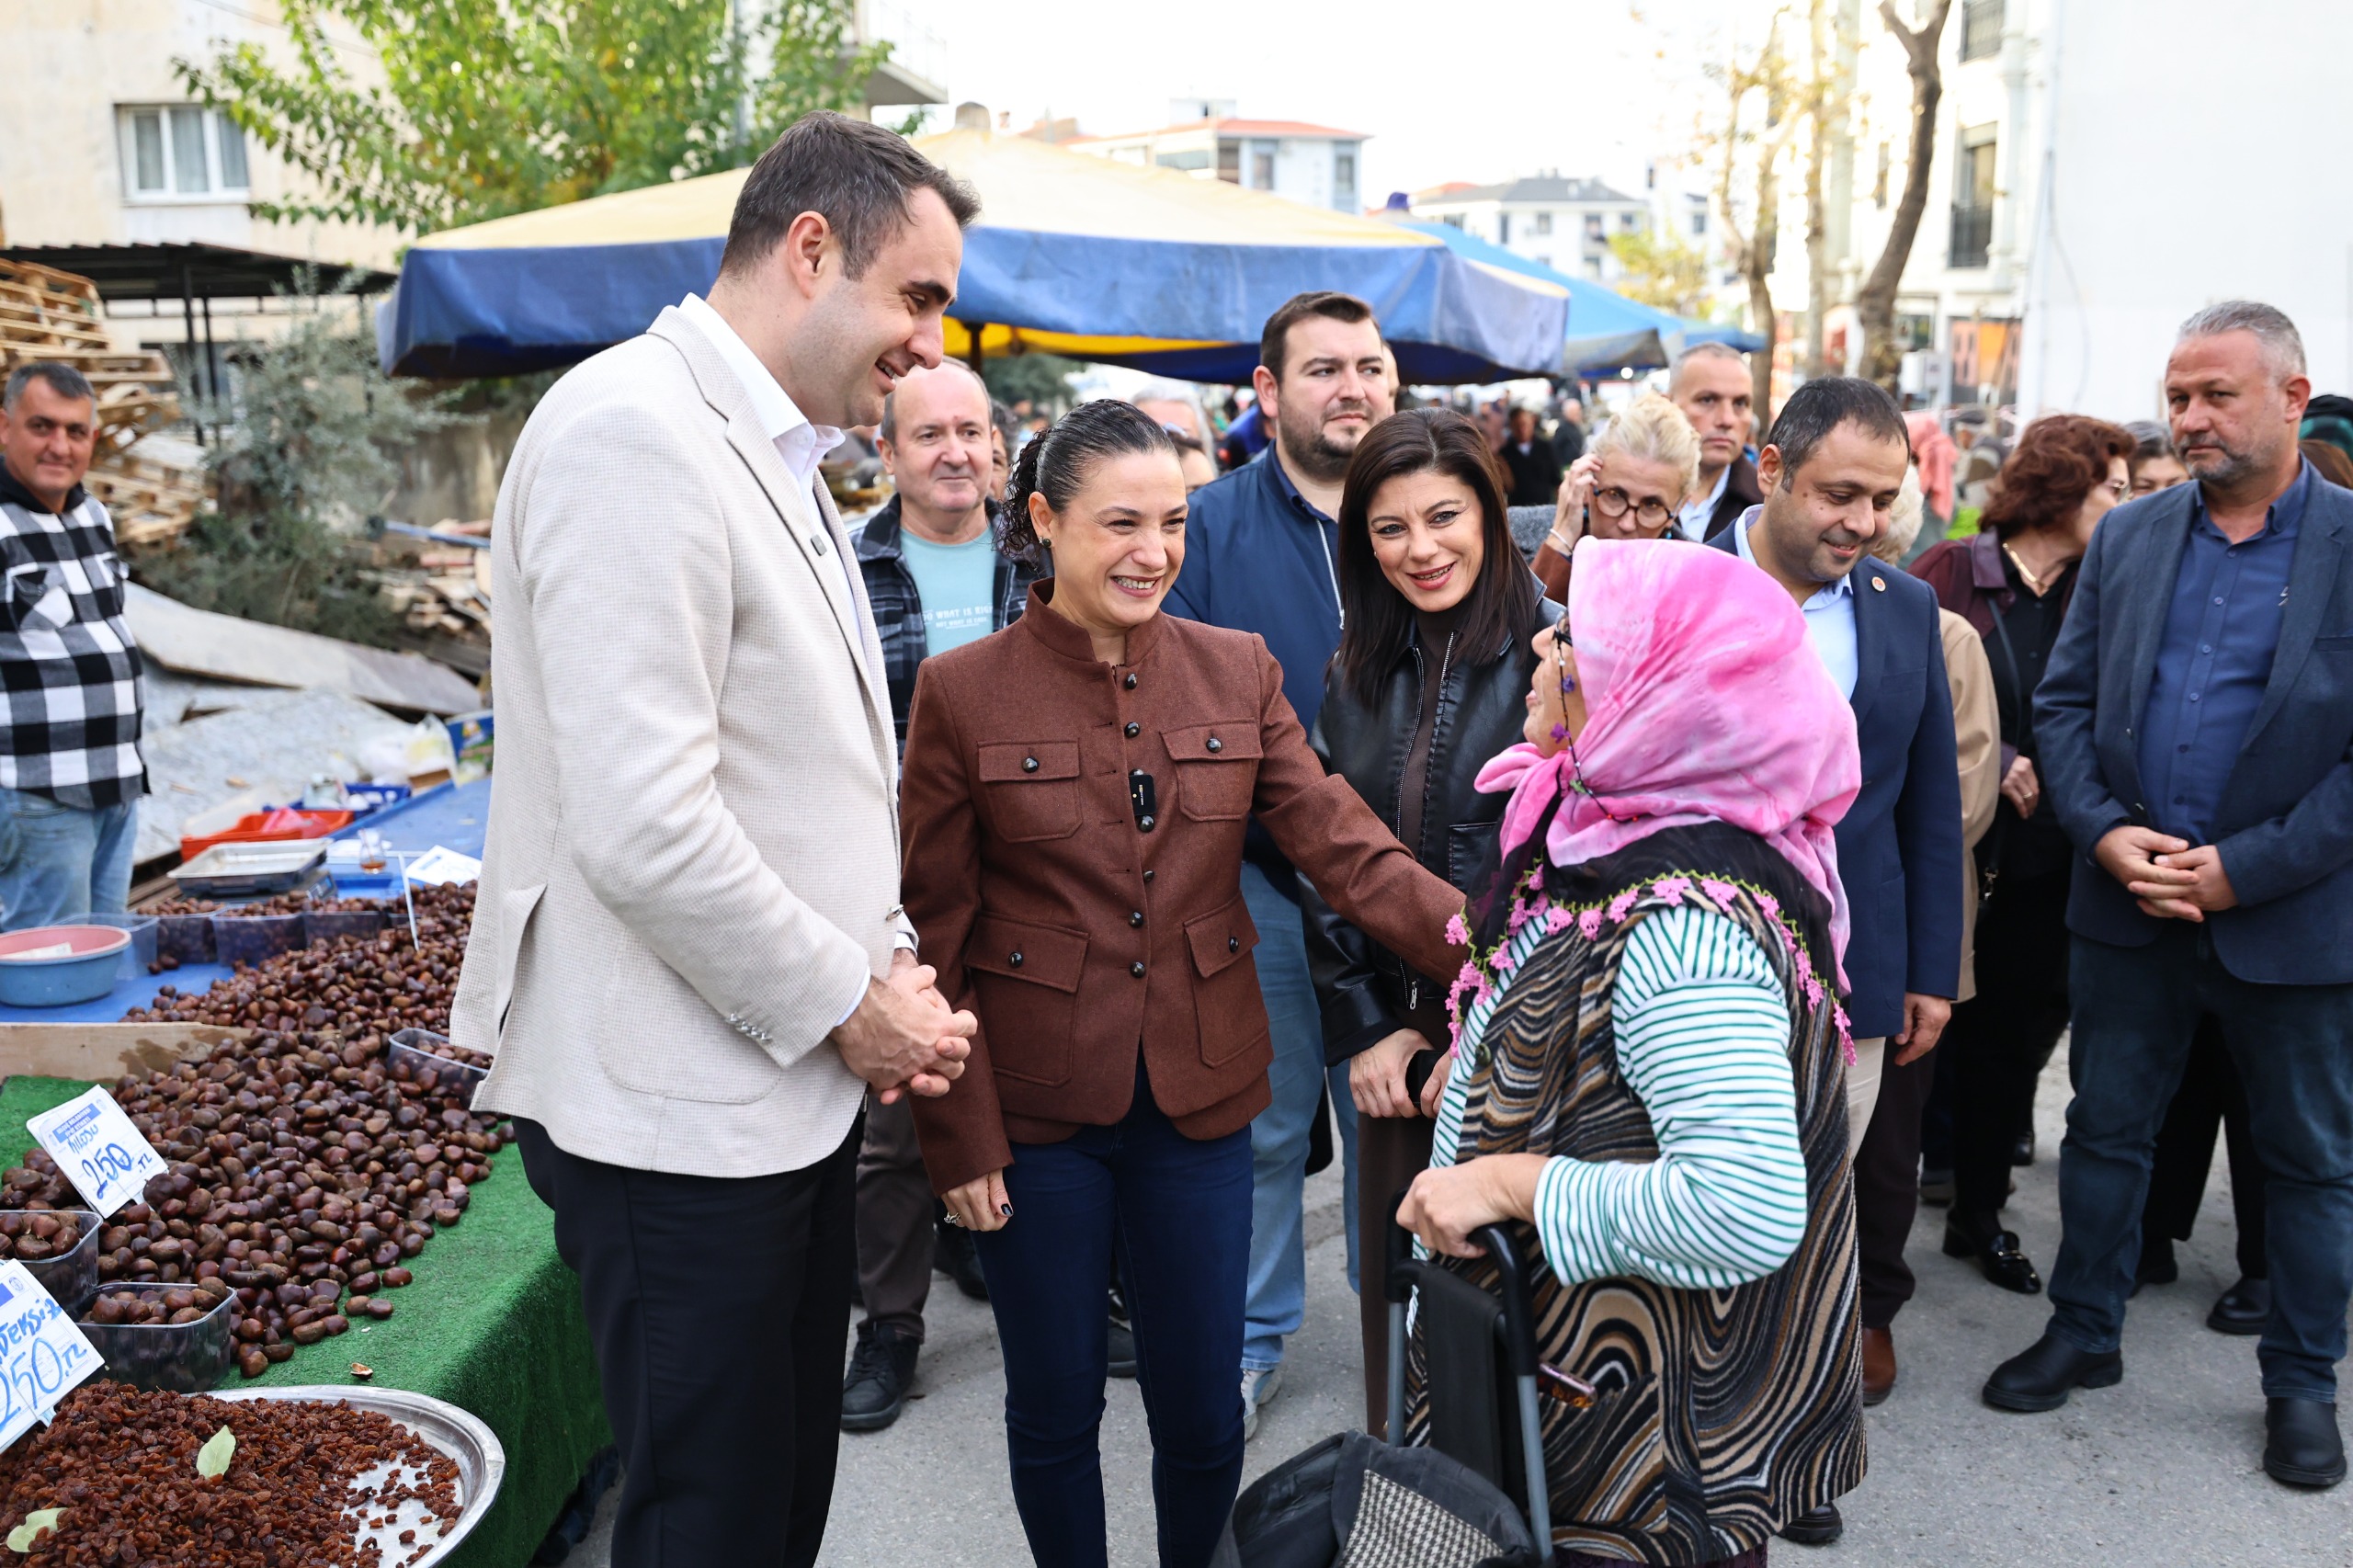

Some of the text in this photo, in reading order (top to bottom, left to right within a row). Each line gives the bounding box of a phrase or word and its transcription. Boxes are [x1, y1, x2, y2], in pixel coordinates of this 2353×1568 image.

[936, 609, 960, 619] WHAT
[963, 608, 972, 617] IS
[82, 1142, 134, 1200] 250
